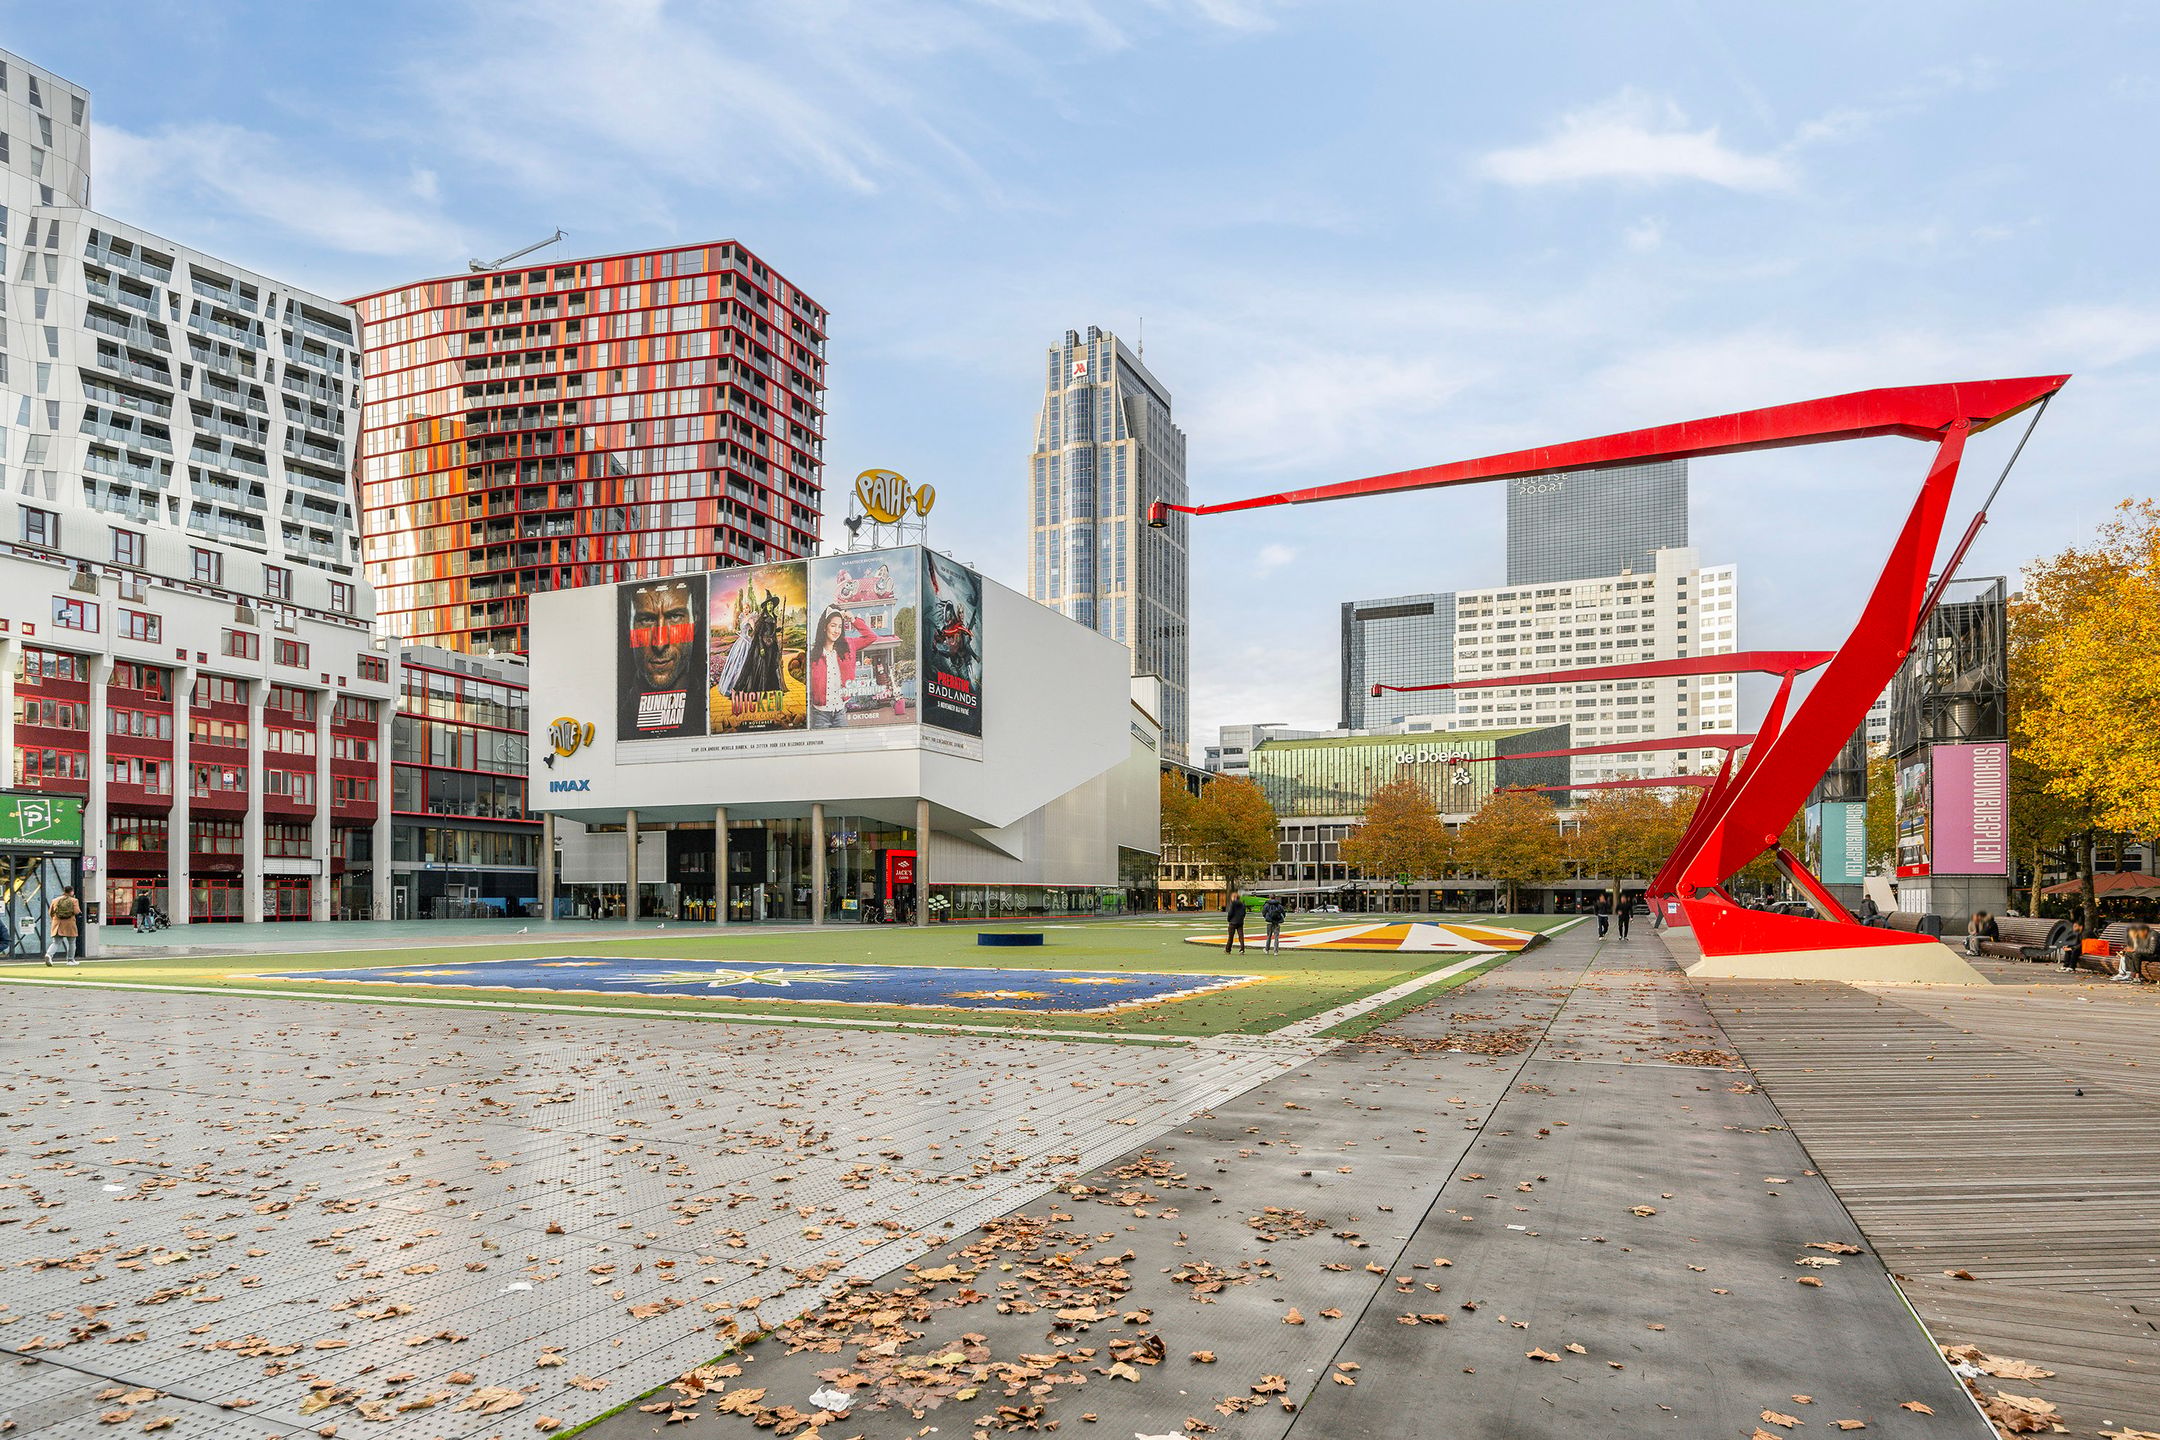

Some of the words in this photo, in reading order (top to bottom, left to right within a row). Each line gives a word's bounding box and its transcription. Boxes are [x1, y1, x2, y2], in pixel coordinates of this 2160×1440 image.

[639, 692, 687, 712] RUNNING
[731, 688, 783, 717] WICKED
[928, 682, 977, 706] BADLANDS
[660, 708, 685, 726] MAN
[852, 712, 880, 720] OKTOBER
[1395, 750, 1414, 764] de
[1417, 749, 1470, 764] Doelen
[549, 779, 591, 793] IMAX
[1973, 747, 2001, 863] SCHOUWBURGPLEIN
[13, 837, 74, 846] Schouwburgplein
[1845, 804, 1863, 877] SCHOUWBURGPLEIN
[955, 893, 1028, 911] JACK'S
[1042, 893, 1094, 910] CASINO
